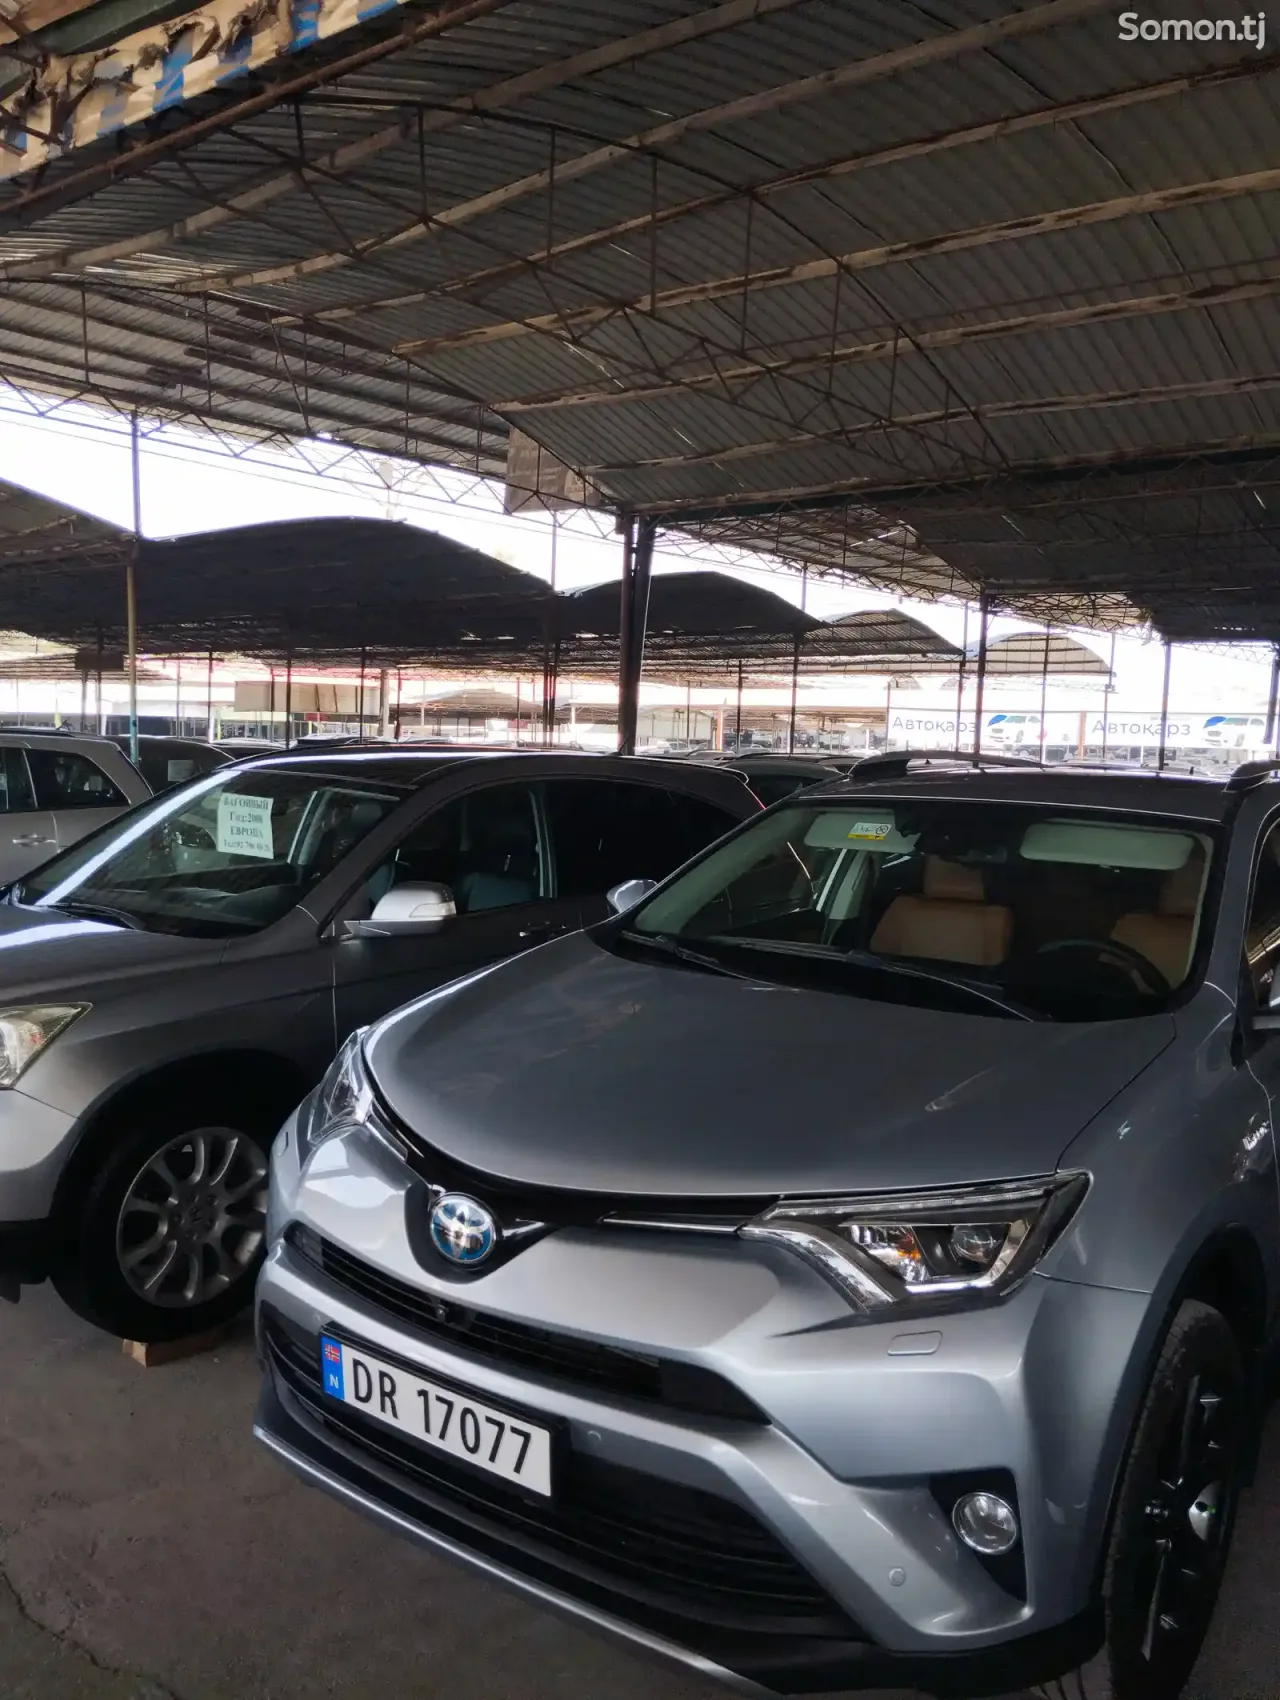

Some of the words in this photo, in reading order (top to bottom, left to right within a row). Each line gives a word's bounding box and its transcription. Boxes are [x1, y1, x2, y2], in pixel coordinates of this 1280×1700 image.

[329, 1374, 339, 1389] N
[352, 1357, 399, 1420] DR
[416, 1388, 532, 1475] 17077
